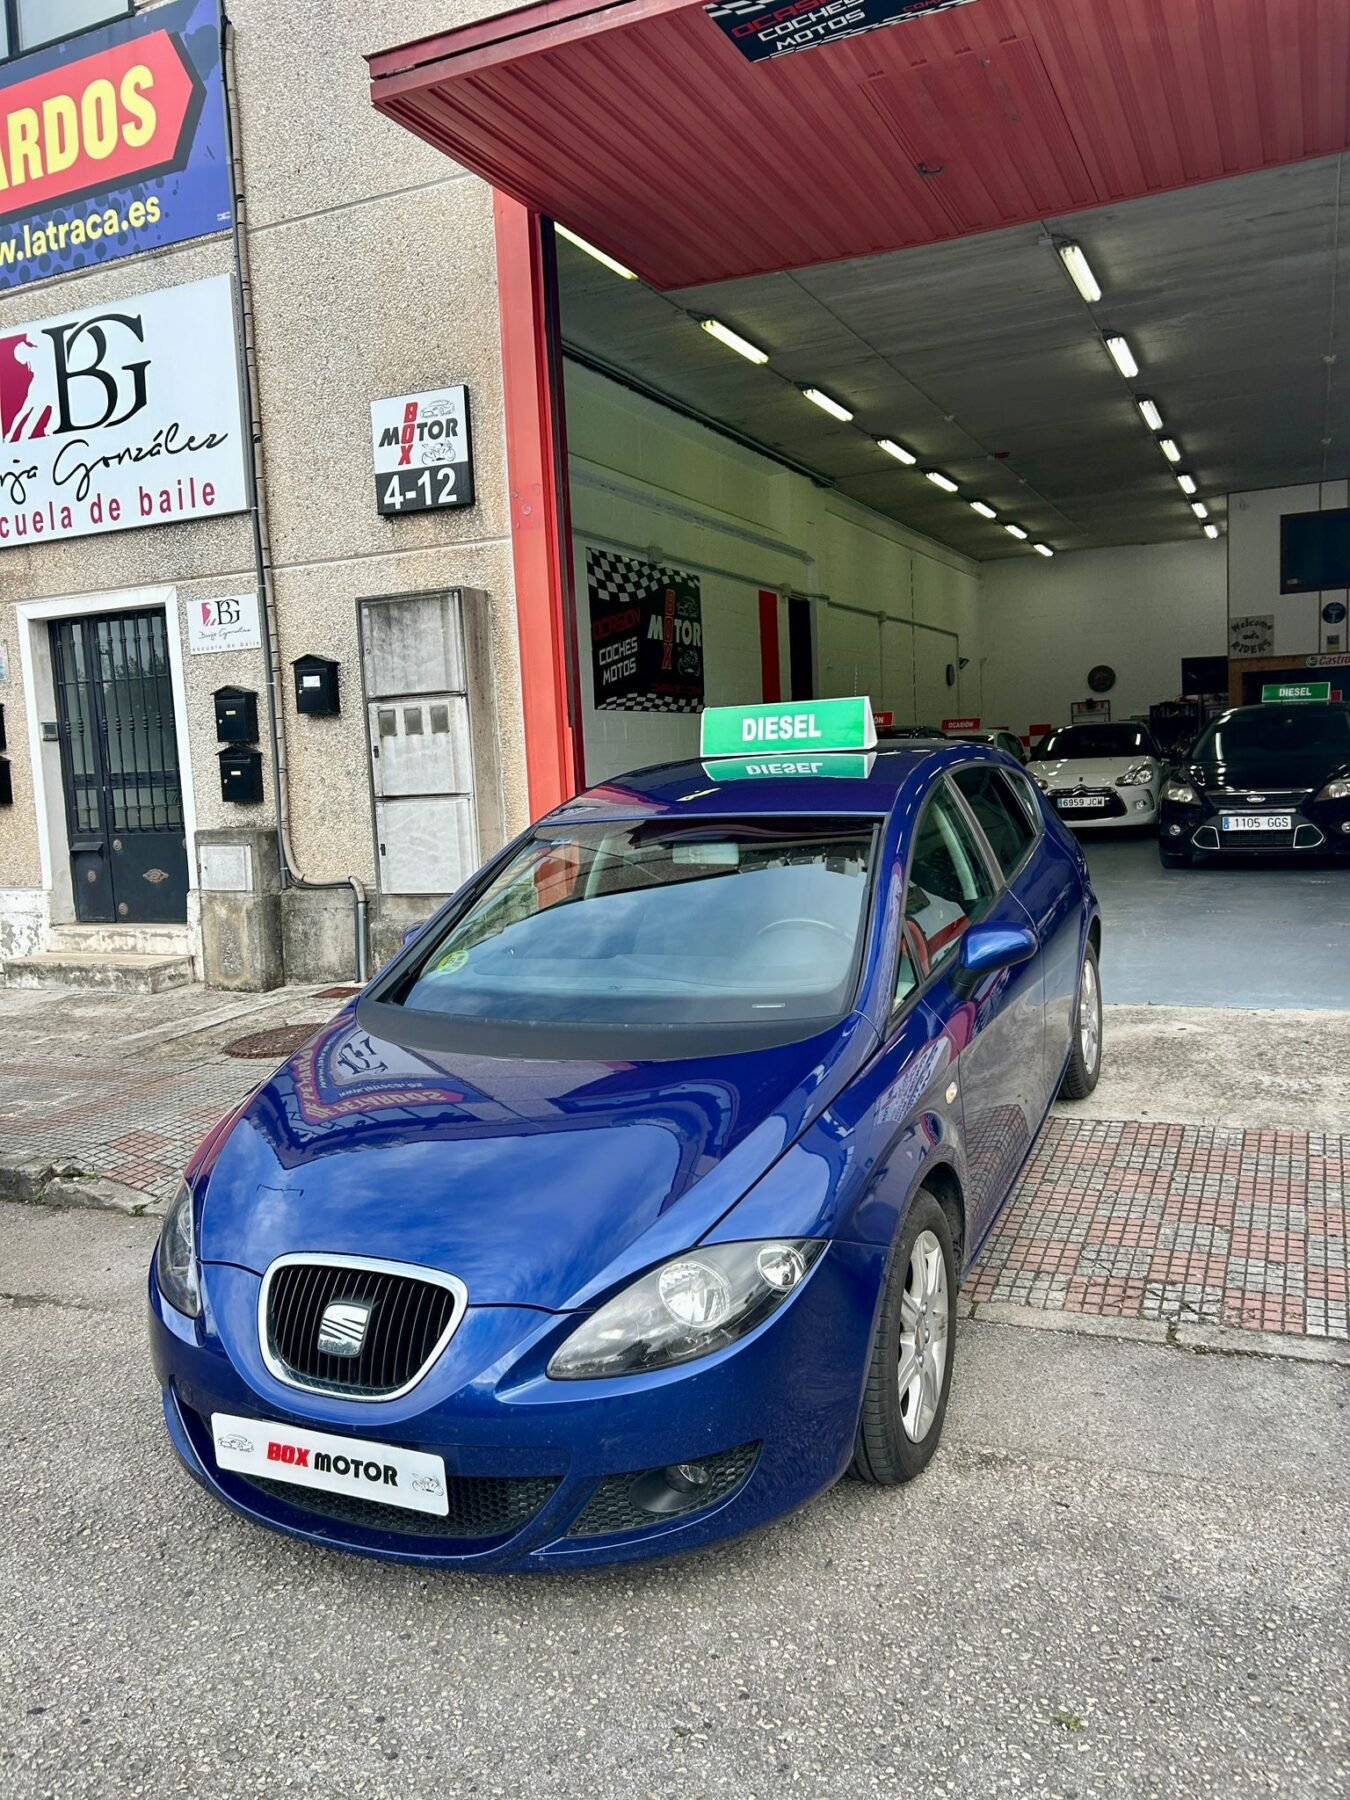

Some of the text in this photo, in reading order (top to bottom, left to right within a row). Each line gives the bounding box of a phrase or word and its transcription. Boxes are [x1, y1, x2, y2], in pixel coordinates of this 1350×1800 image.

[776, 9, 866, 51] MOTOS
[90, 493, 121, 525] de
[139, 477, 216, 517] baile
[383, 467, 458, 510] 4-12
[599, 637, 638, 665] COCHES
[603, 657, 637, 686] MOTOS
[1279, 687, 1312, 697] DIESEL
[742, 714, 822, 742] DIESEL
[1063, 798, 1085, 807] 6959
[1235, 817, 1289, 828] 1105 GGS
[266, 1441, 398, 1487] BOX MOTOR
